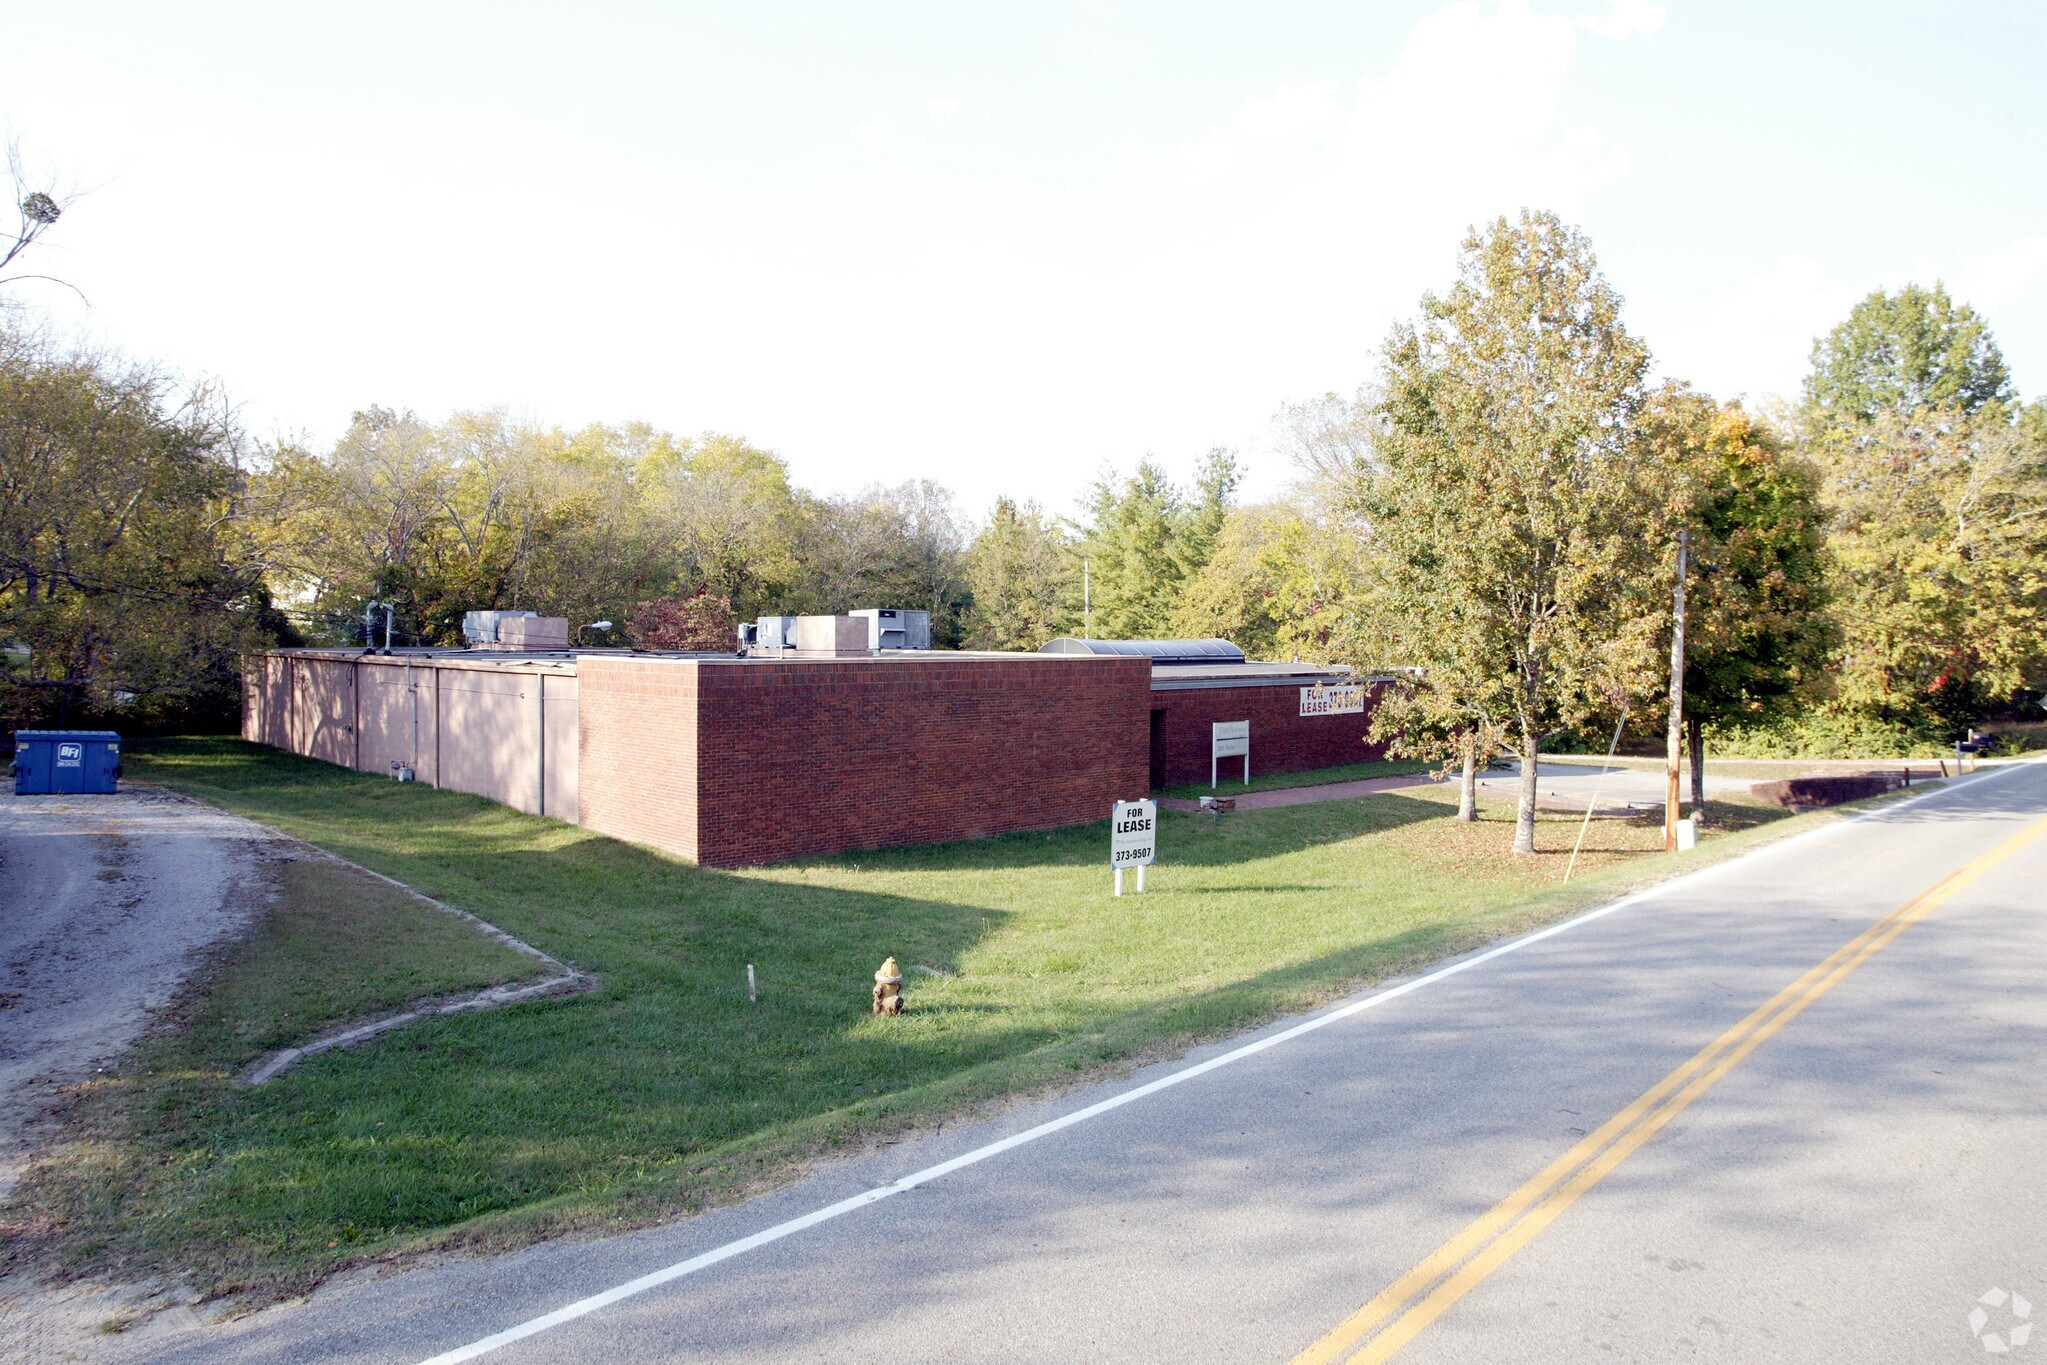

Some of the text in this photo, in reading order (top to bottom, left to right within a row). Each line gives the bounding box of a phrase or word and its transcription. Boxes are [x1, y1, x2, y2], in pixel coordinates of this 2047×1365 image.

[1301, 701, 1328, 713] LEASE
[60, 746, 79, 758] BFI
[1127, 808, 1143, 818] FOR
[1117, 819, 1151, 833] LEASE
[1115, 847, 1151, 861] 373-9507
